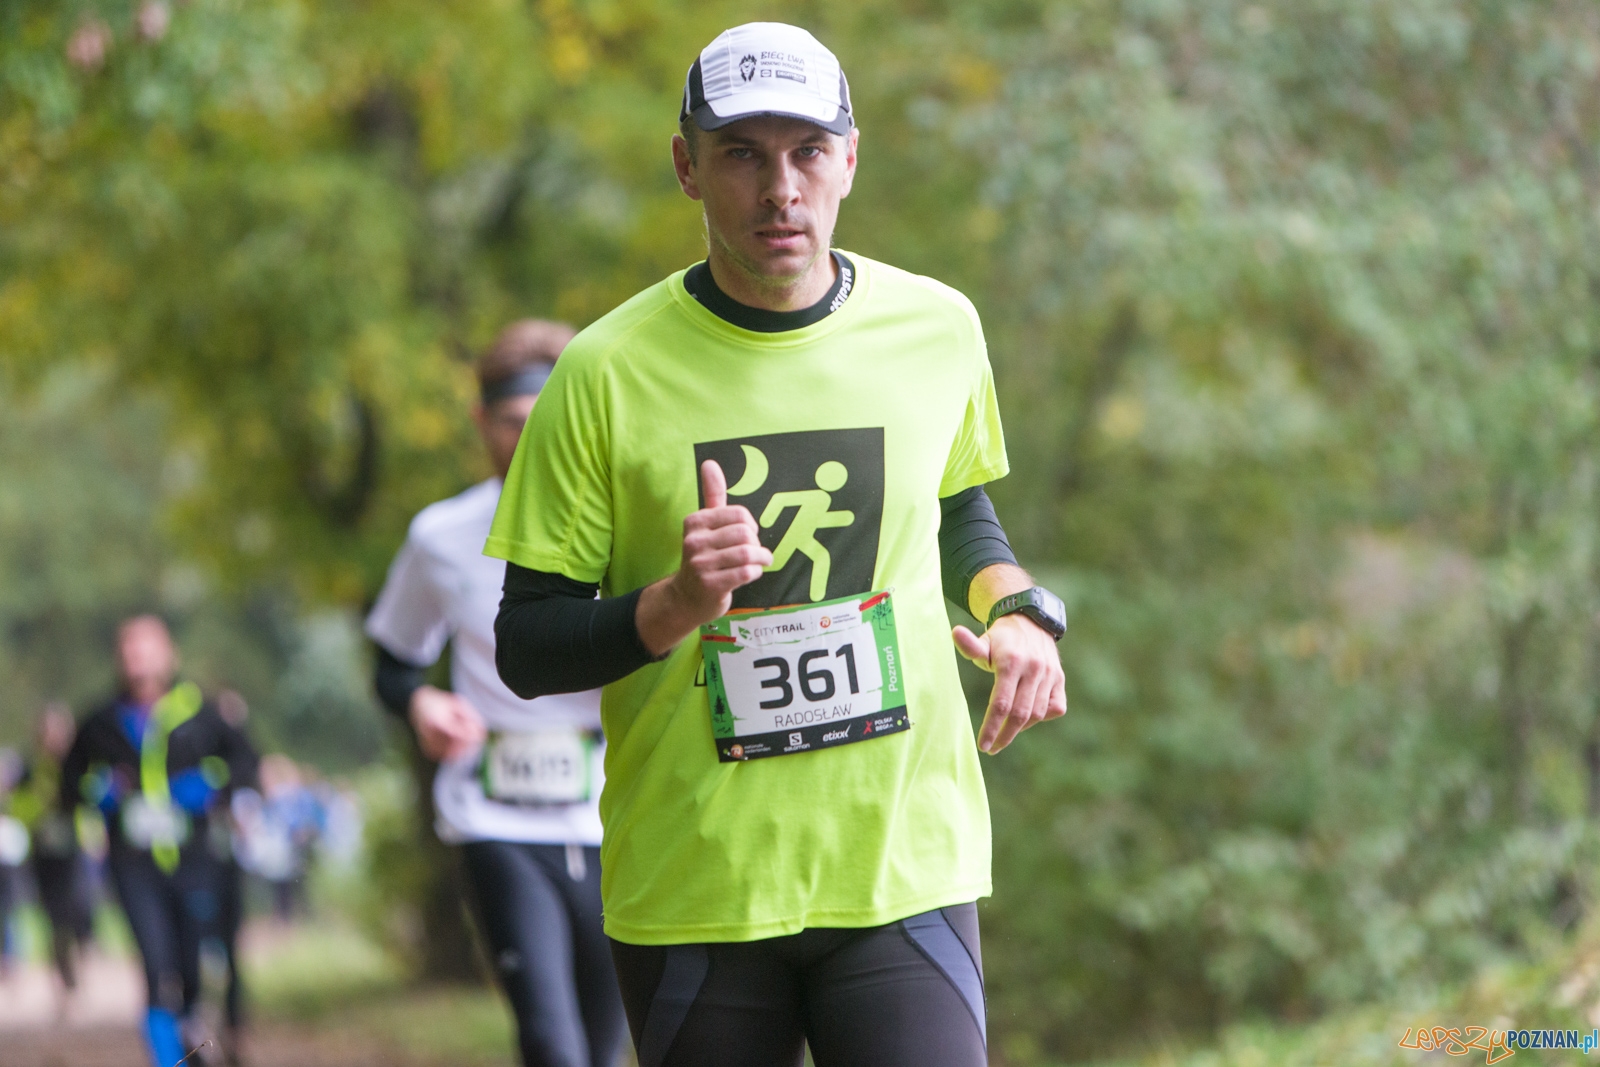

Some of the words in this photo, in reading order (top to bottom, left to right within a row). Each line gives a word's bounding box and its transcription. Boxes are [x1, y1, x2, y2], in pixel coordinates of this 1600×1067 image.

[760, 51, 784, 60] BIEG
[787, 54, 805, 66] LWA
[753, 643, 860, 710] 361
[883, 645, 898, 692] Poznań
[774, 703, 852, 728] RADOSŁAW
